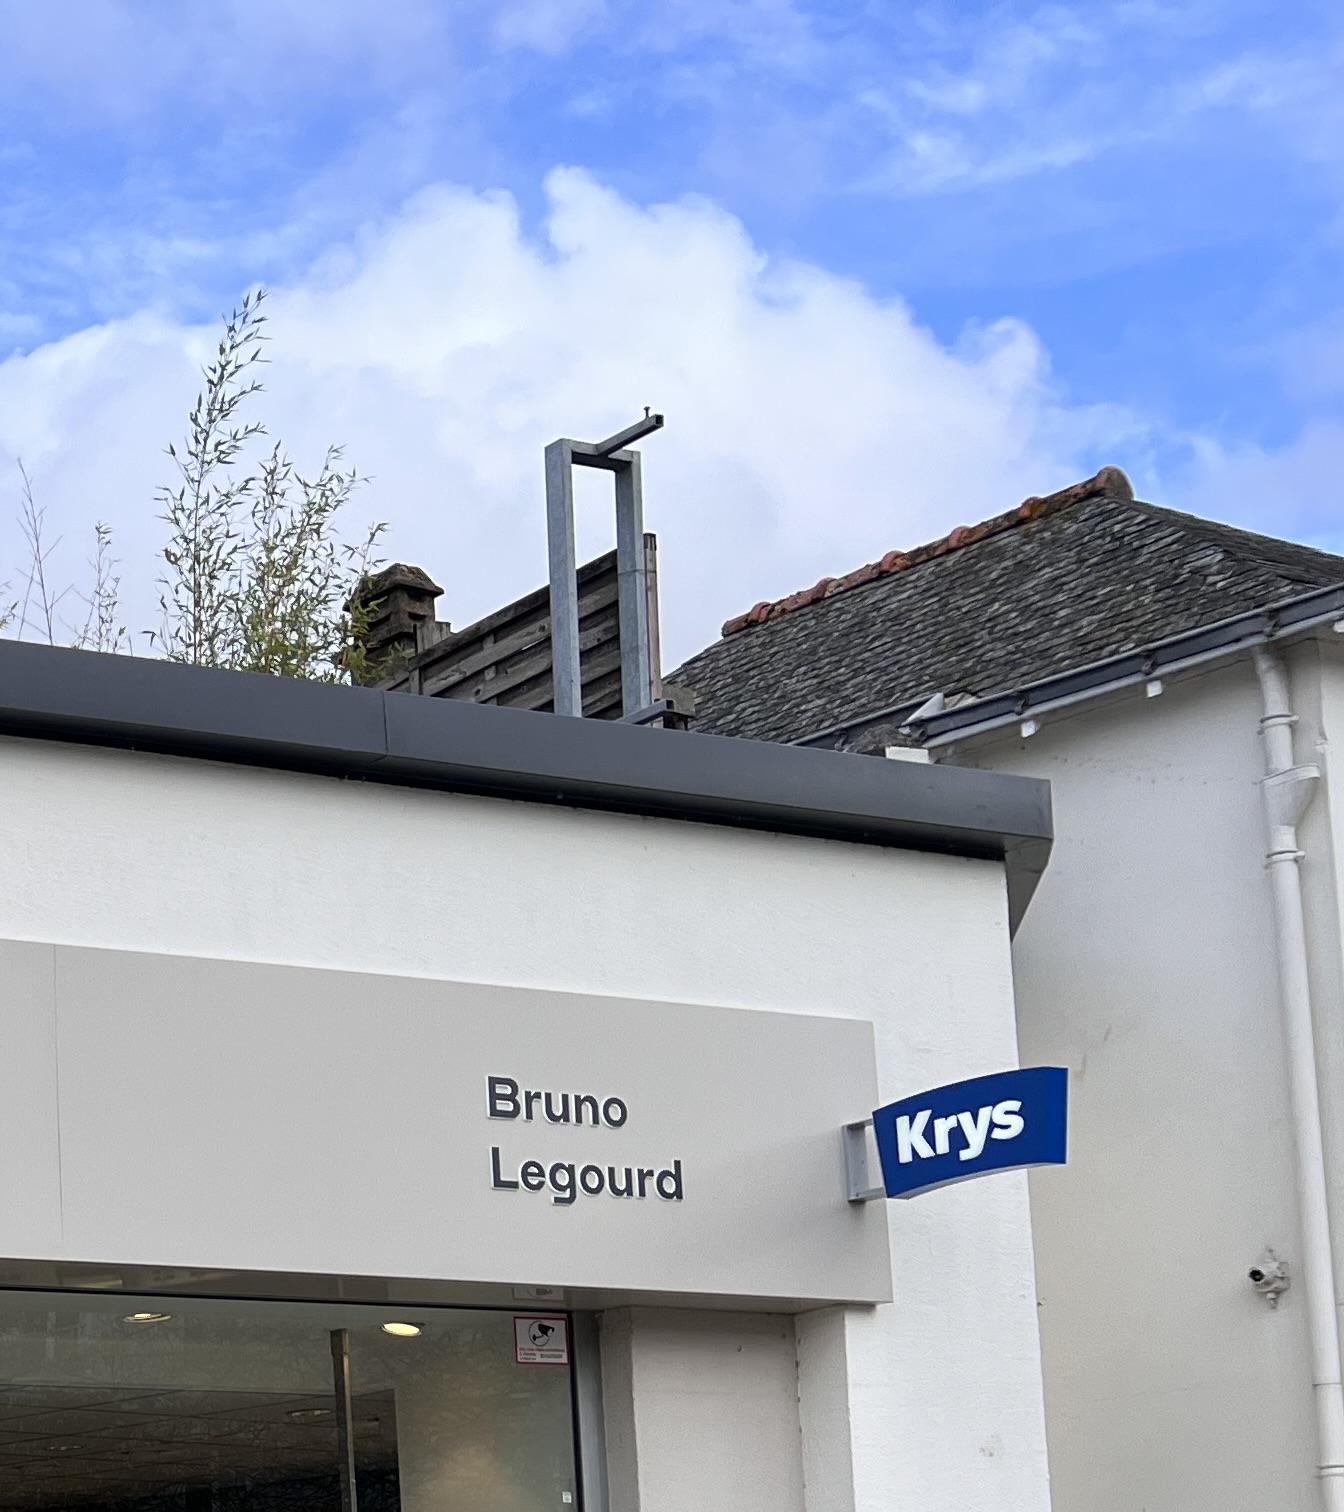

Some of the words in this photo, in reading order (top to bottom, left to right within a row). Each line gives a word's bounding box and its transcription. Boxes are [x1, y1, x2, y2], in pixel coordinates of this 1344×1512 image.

[486, 1075, 628, 1128] Bruno
[896, 1100, 1025, 1164] Krys
[490, 1146, 684, 1205] Legourd
